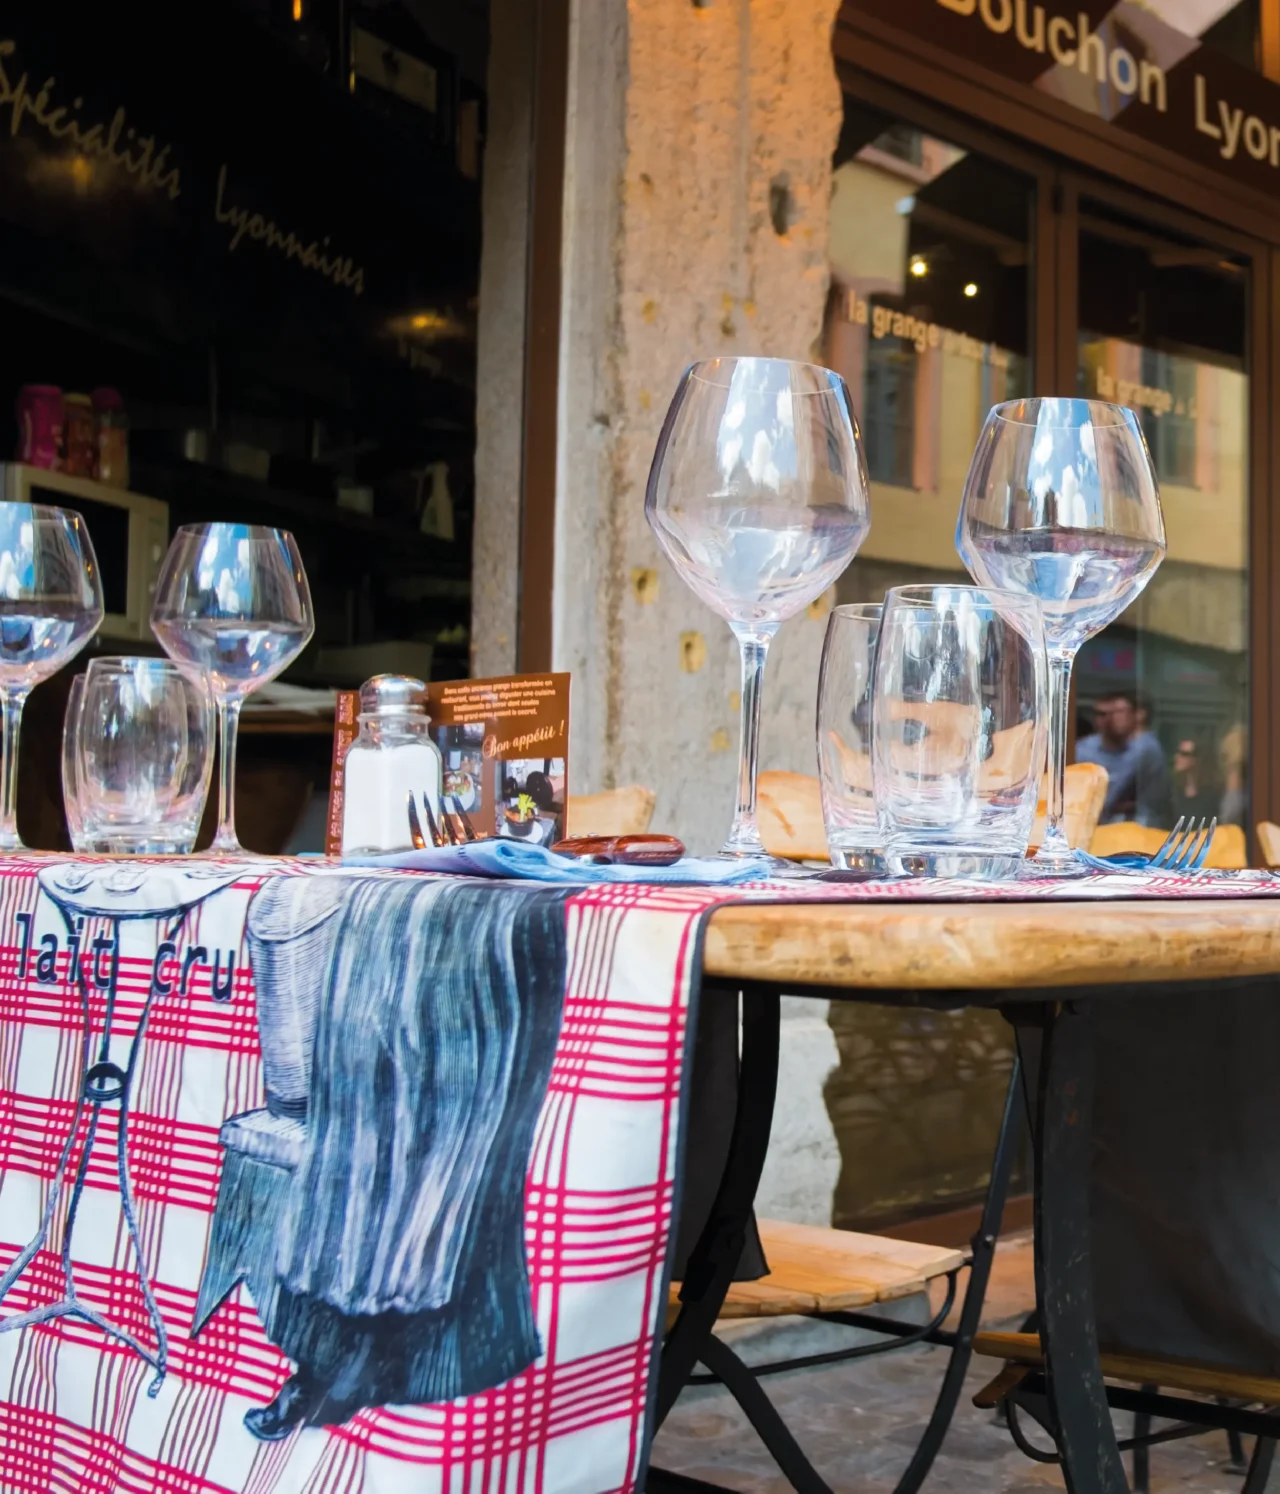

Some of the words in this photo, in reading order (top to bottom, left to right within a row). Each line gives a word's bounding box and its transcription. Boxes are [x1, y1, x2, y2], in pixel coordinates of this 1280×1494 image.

[215, 163, 364, 296] Lyonnaises
[849, 290, 868, 325] la
[872, 305, 940, 353] grange
[482, 734, 511, 758] Bon
[512, 726, 556, 752] appétit
[16, 912, 115, 990] lait
[152, 941, 236, 1001] cru
